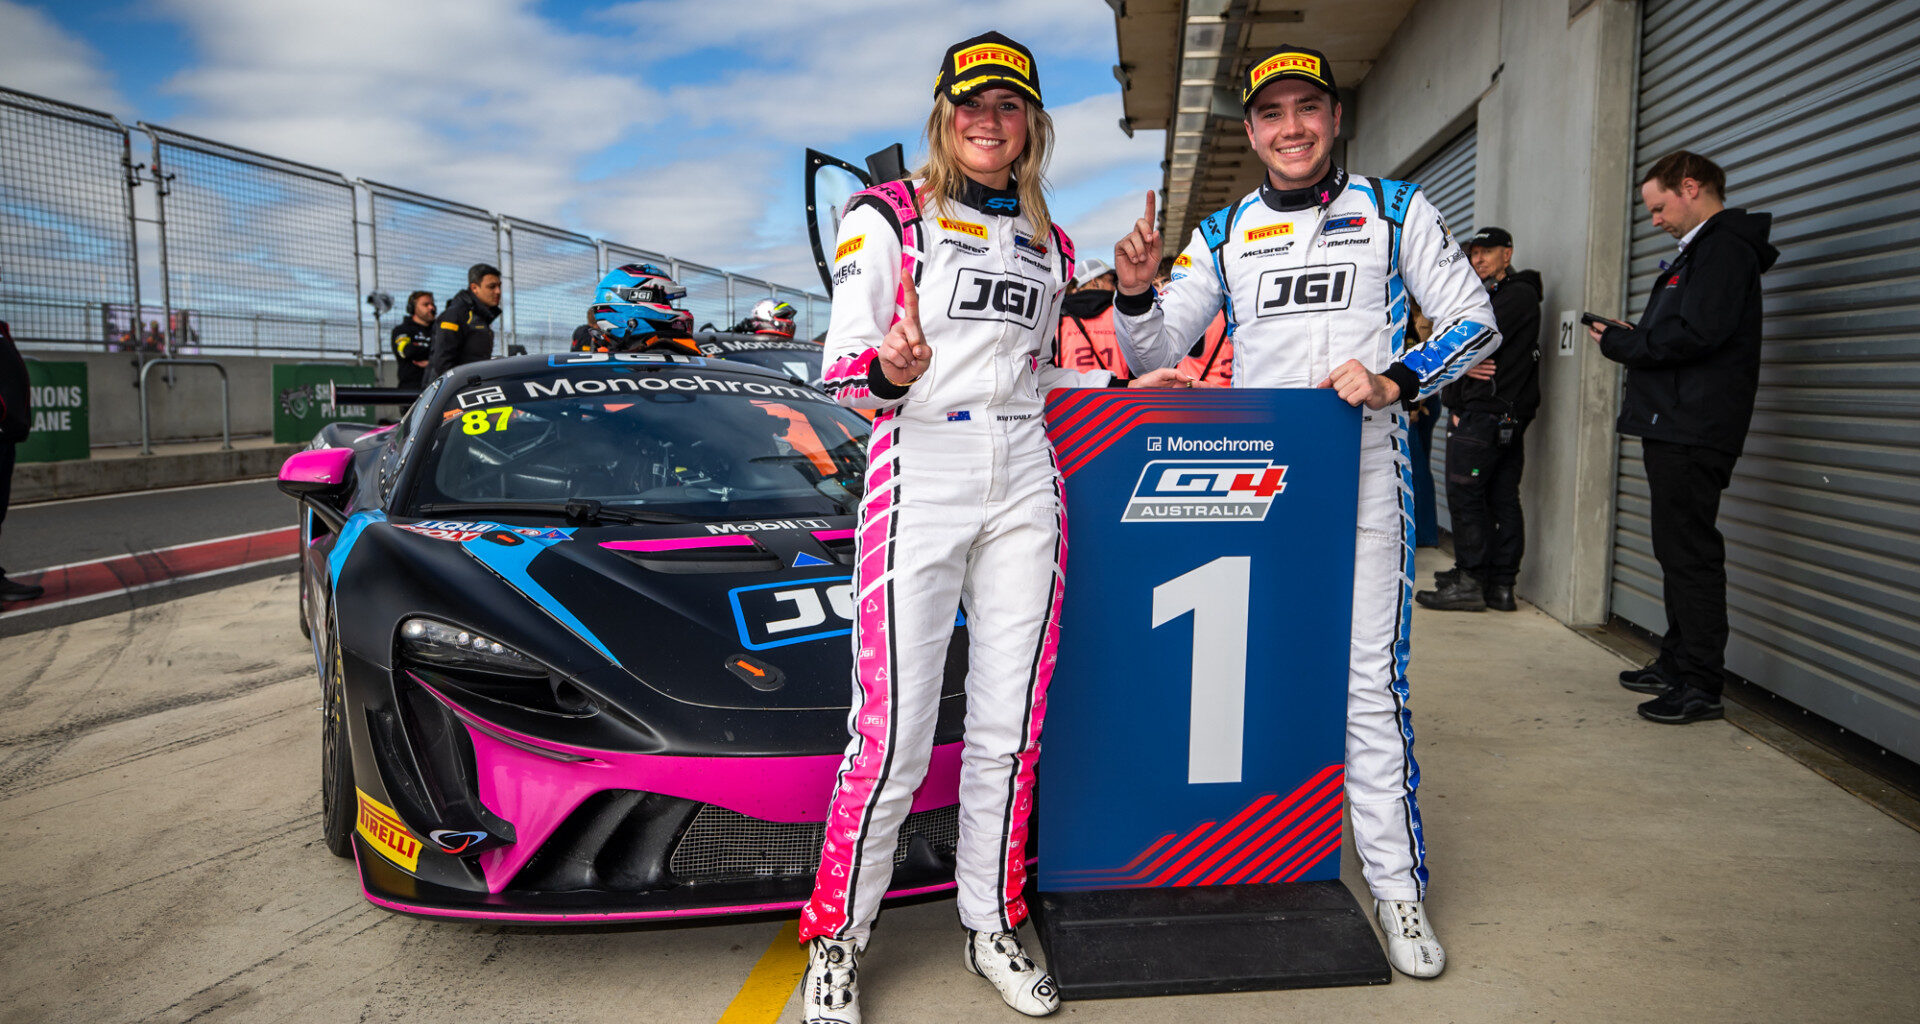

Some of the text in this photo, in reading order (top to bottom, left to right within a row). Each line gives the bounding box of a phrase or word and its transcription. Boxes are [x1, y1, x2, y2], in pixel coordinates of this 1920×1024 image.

[957, 47, 1027, 71] PIRELLI
[1253, 56, 1317, 82] PIRELLI
[985, 197, 1018, 211] SR
[1391, 182, 1412, 212] HRX
[941, 219, 984, 237] PIRELLI
[1248, 224, 1291, 240] PIRELLI
[1240, 241, 1290, 259] McLaren
[631, 291, 651, 300] JGI
[959, 277, 1039, 320] JGI
[1263, 270, 1347, 309] JGI
[1560, 321, 1574, 350] 21
[1074, 347, 1114, 367] 21
[523, 377, 838, 406] Monochrome
[461, 406, 514, 436] 87
[1167, 436, 1275, 452] Monochrome
[1155, 468, 1284, 497] GT4
[1140, 505, 1254, 517] AUSTRALIA
[415, 520, 496, 532] LIQUI
[705, 520, 798, 535] Mobil
[1152, 556, 1251, 784] 1
[359, 796, 418, 859] PIRELLI
